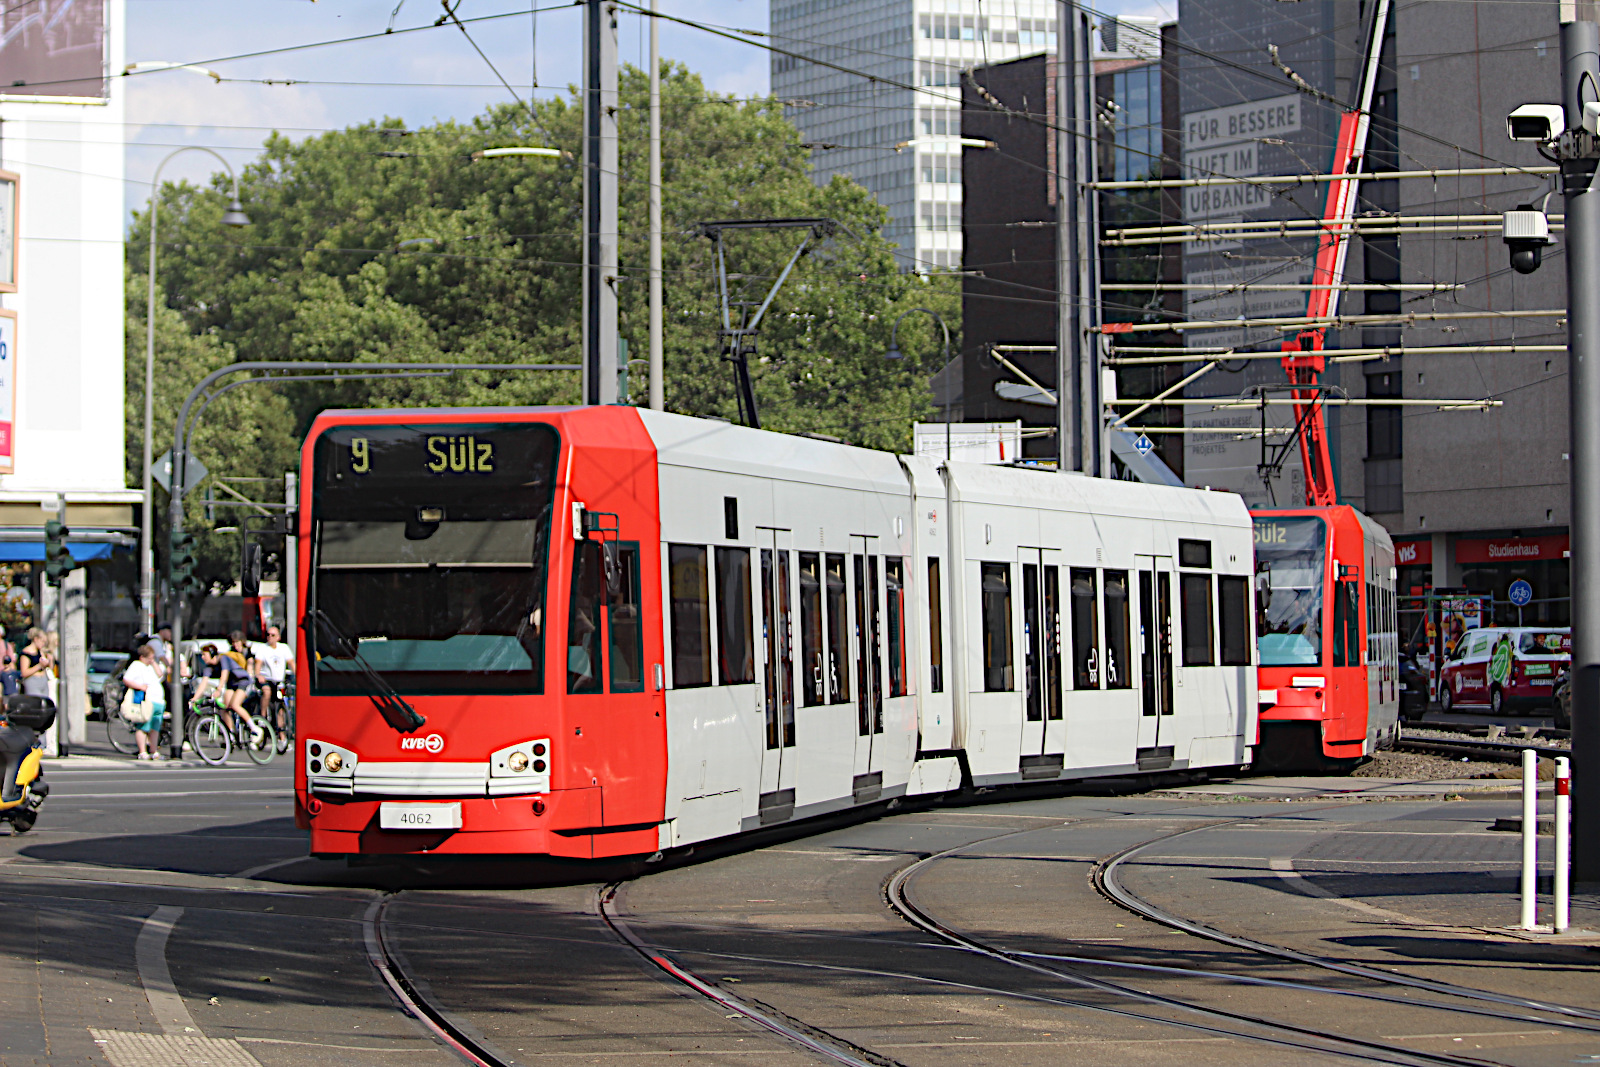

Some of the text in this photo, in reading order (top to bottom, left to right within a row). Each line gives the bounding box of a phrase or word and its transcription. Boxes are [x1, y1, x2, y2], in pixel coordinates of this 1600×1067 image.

[1189, 104, 1295, 142] FÜR BESSERE
[1190, 148, 1252, 179] LUFT IM
[1190, 182, 1264, 213] URBANEN
[352, 436, 494, 473] 9 Sülz
[1254, 522, 1287, 543] Sülz
[1398, 544, 1417, 562] VHS
[1488, 543, 1539, 557] Studienhaus
[401, 738, 426, 750] KVB
[400, 813, 432, 825] 4062
